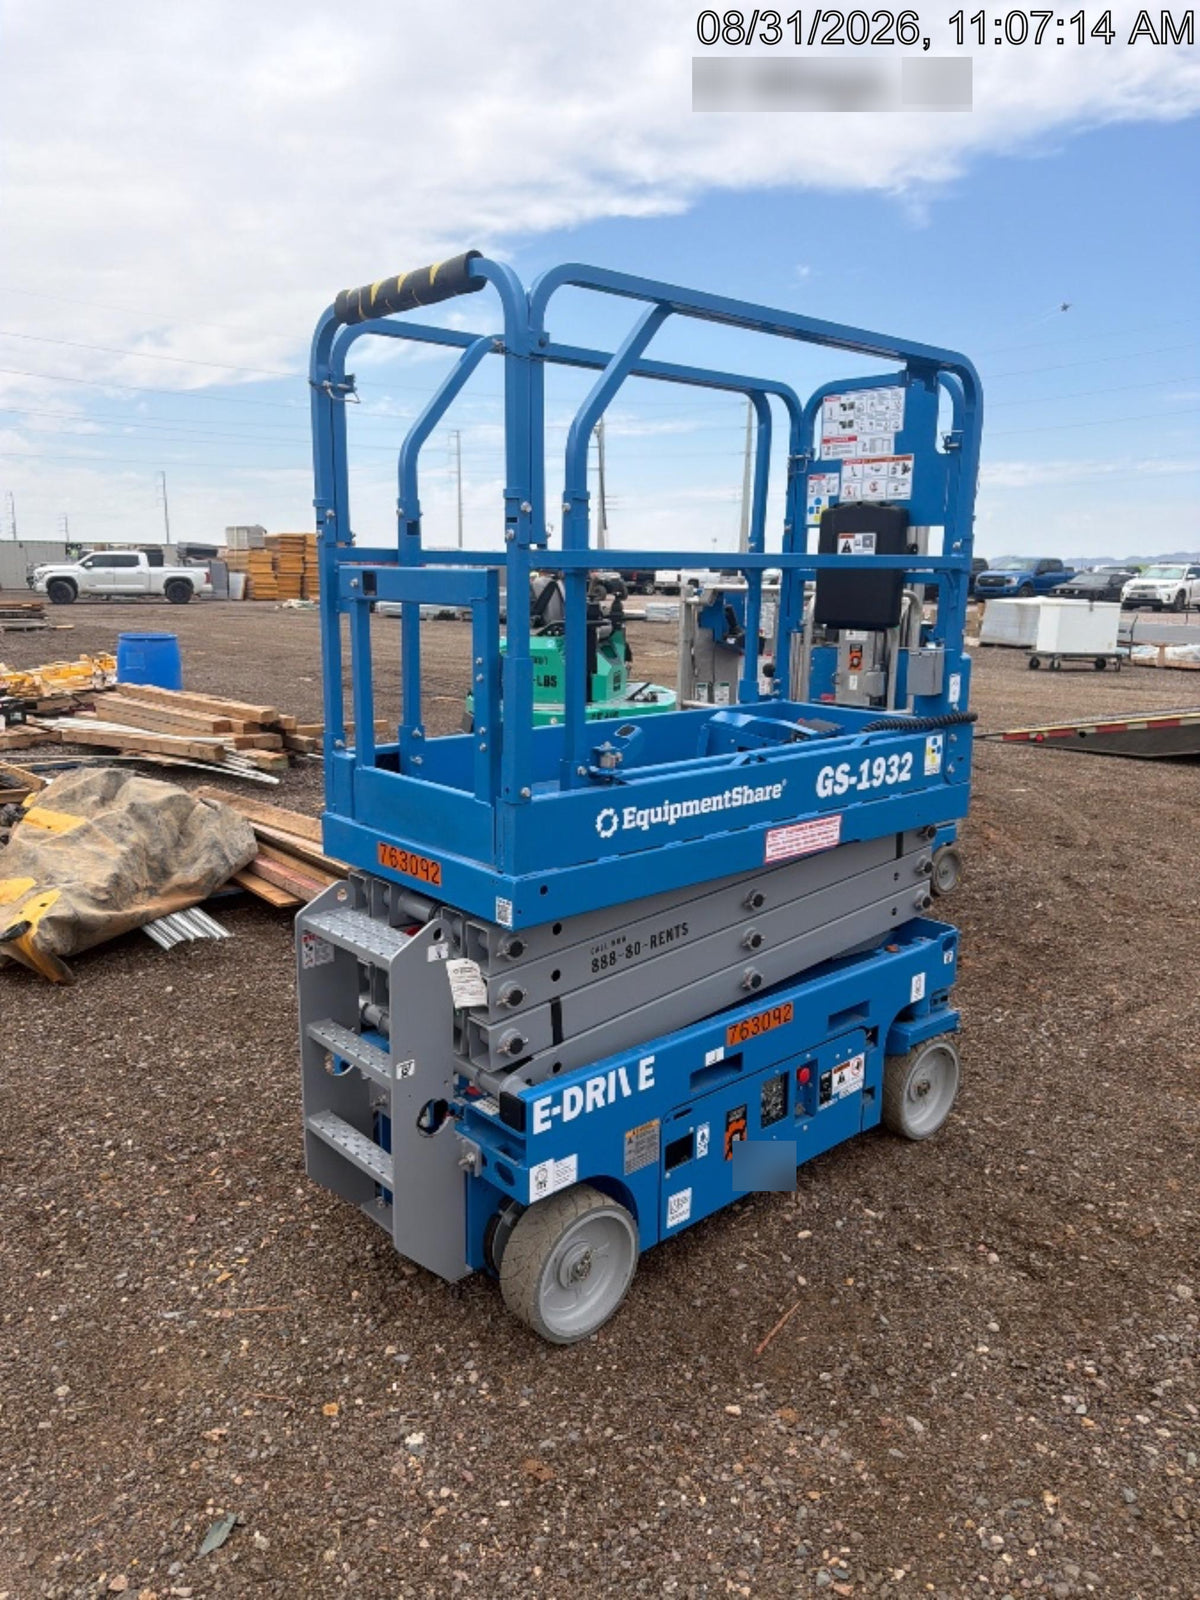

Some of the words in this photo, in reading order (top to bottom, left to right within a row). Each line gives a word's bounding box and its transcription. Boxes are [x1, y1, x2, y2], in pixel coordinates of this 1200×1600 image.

[816, 751, 913, 799] GS-1932
[379, 842, 440, 885] 763092
[591, 922, 689, 974] 888-80-RENTS
[728, 1003, 792, 1046] 763092
